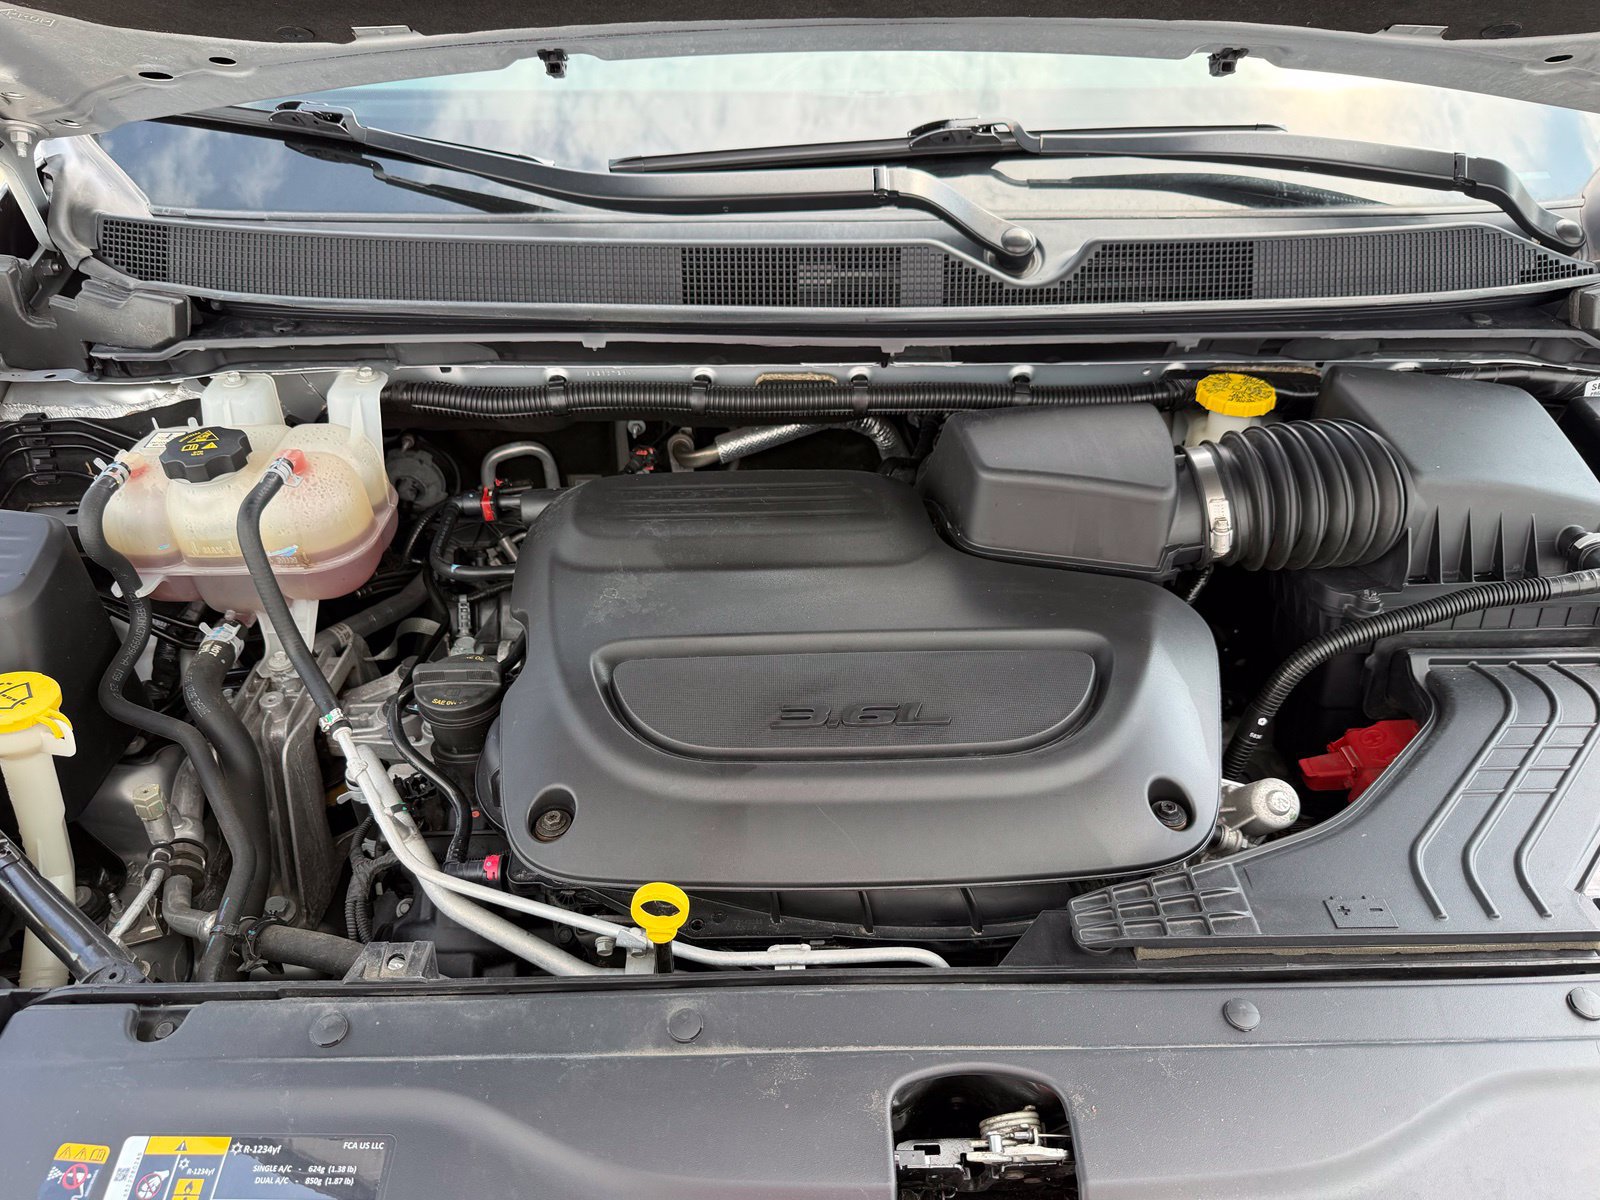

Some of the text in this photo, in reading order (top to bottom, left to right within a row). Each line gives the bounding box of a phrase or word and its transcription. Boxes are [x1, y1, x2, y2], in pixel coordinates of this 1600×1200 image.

[770, 702, 951, 729] 3.6L
[243, 1145, 282, 1155] R-1234yf
[278, 1165, 292, 1173] A/C
[308, 1165, 326, 1174] 624g
[328, 1165, 346, 1174] (1.38
[347, 1165, 357, 1174] lb)
[274, 1176, 289, 1185] A/C
[305, 1177, 323, 1186] 850g
[325, 1177, 343, 1186] (1.87
[344, 1177, 354, 1186] lb)
